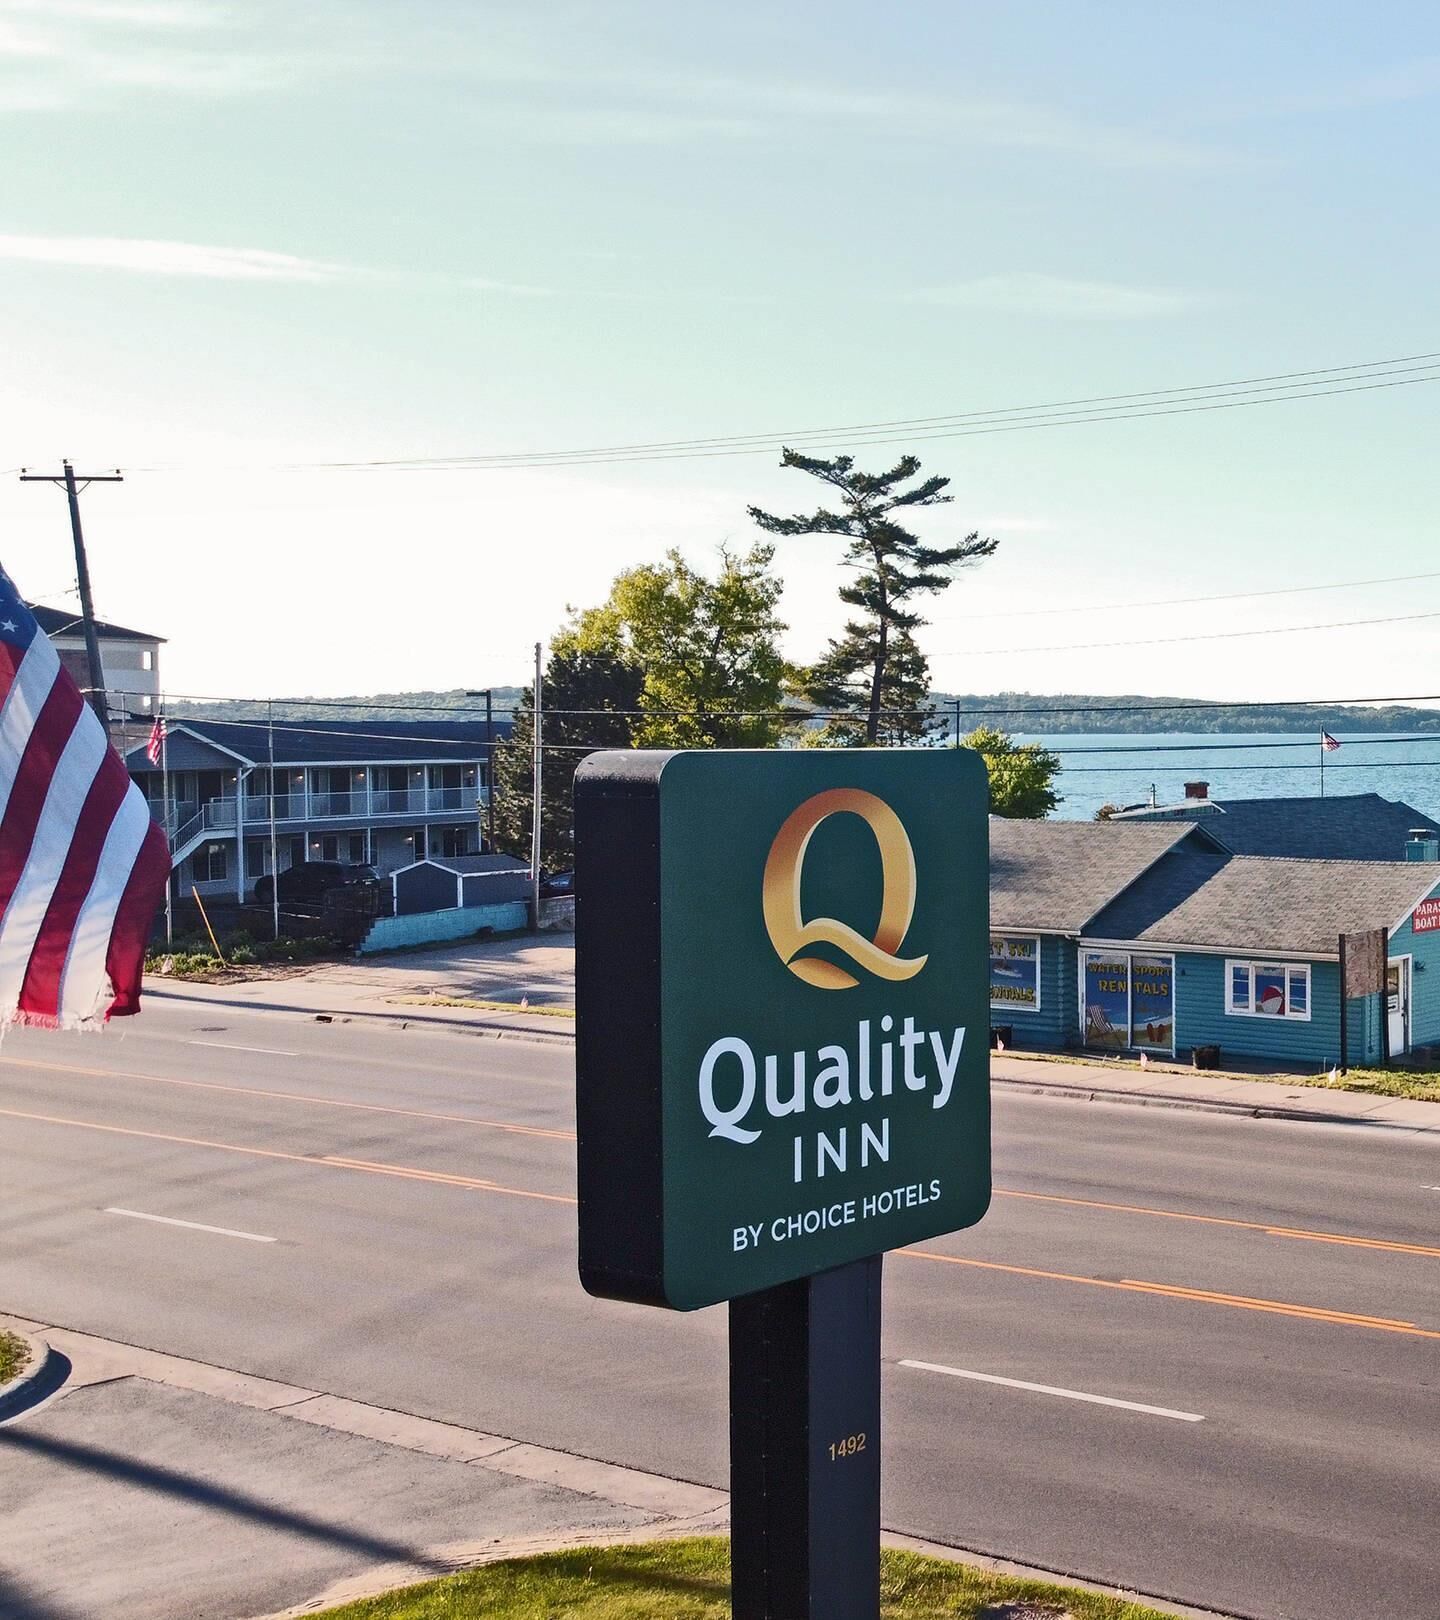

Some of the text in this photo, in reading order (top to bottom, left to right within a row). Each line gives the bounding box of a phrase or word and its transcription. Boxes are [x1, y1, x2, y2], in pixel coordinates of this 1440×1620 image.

[762, 787, 929, 990] Q
[1415, 915, 1438, 929] BOAT
[1008, 943, 1032, 957] SKI
[1088, 962, 1171, 977] WATER SPORT
[1098, 979, 1169, 996] RENTALS
[698, 1015, 966, 1144] Quality
[793, 1118, 889, 1183] INN
[733, 1179, 941, 1252] BY CHOICE HOTELS
[829, 1433, 866, 1461] 1492
